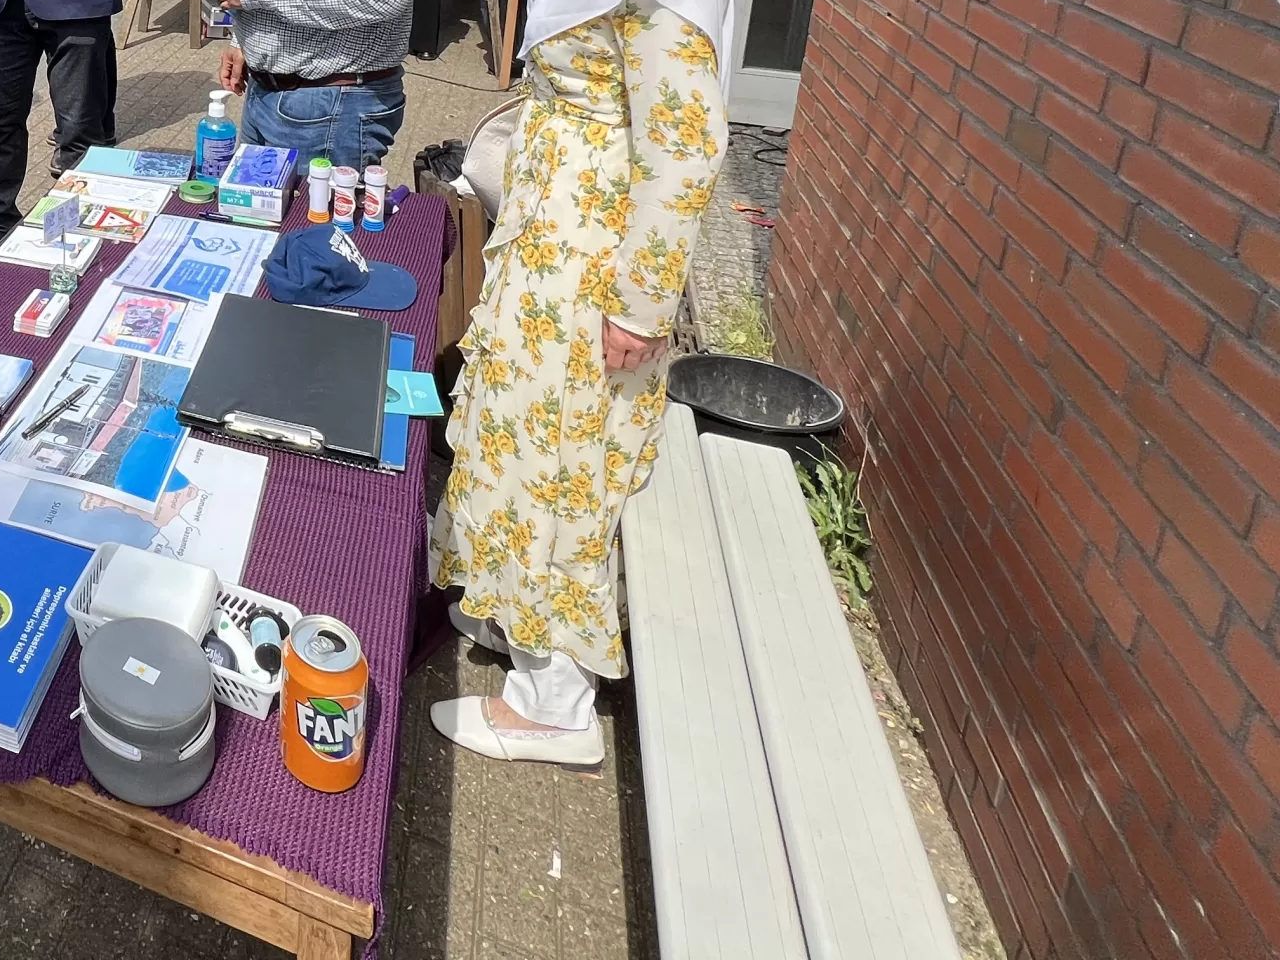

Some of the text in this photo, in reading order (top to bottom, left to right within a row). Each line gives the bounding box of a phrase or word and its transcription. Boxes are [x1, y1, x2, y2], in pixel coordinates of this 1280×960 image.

[193, 447, 205, 464] Adana
[194, 493, 209, 522] Osmaniye
[176, 526, 193, 557] Gaziantep
[16, 585, 67, 674] Depresyonlu hastalar ve
[19, 633, 28, 642] el
